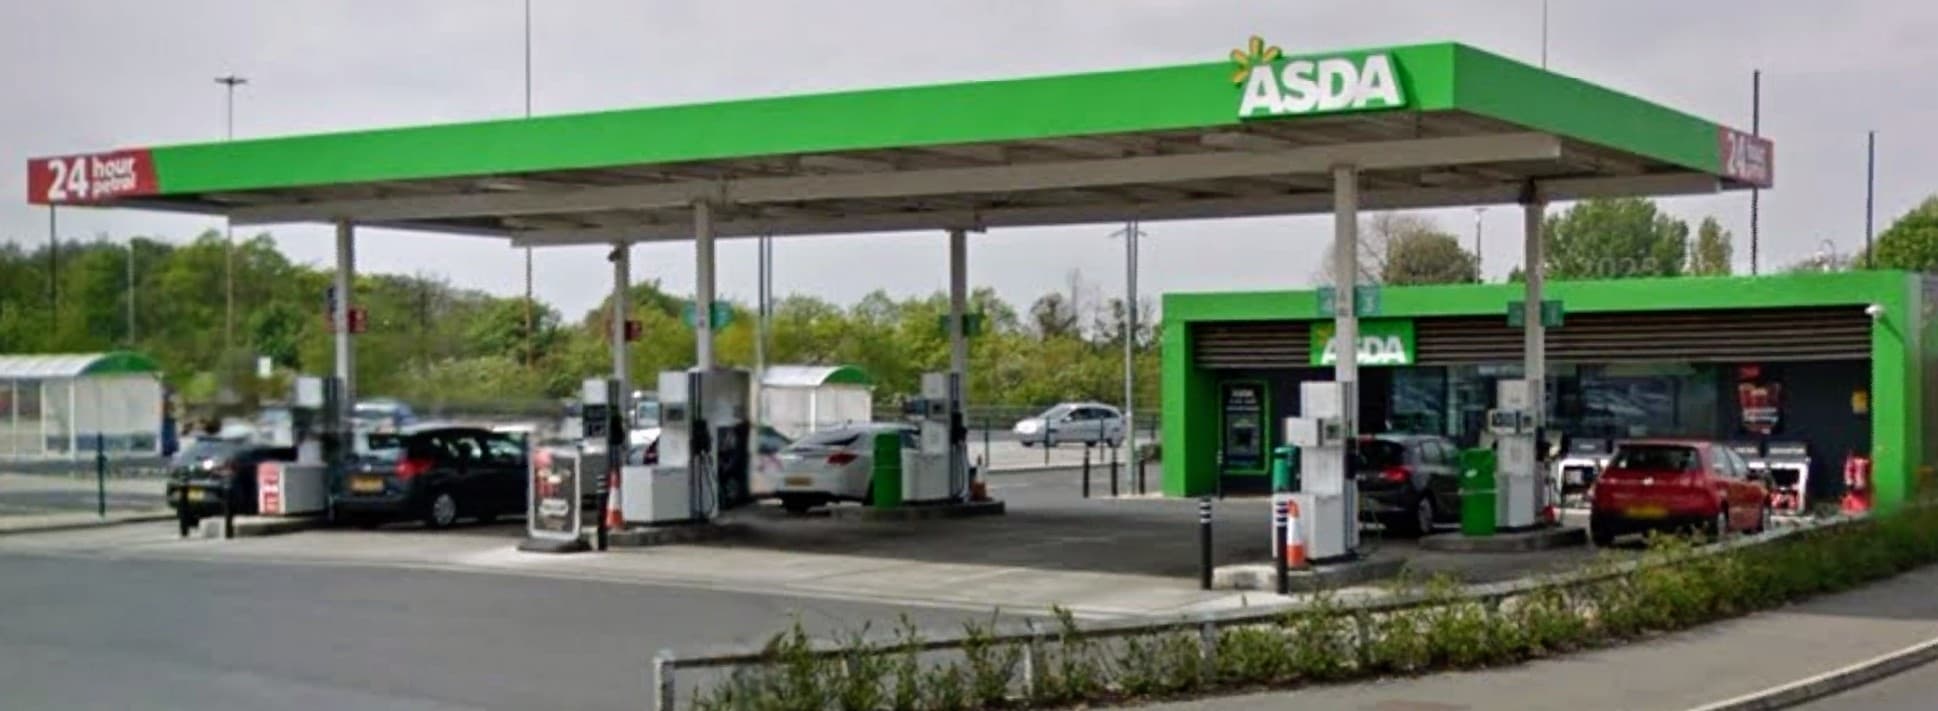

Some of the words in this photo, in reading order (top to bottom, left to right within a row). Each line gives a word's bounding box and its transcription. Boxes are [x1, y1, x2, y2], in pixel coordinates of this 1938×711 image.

[1238, 54, 1406, 117] ASDA
[47, 157, 88, 200] 24
[92, 156, 135, 178] hour
[1321, 335, 1407, 365] ADA
